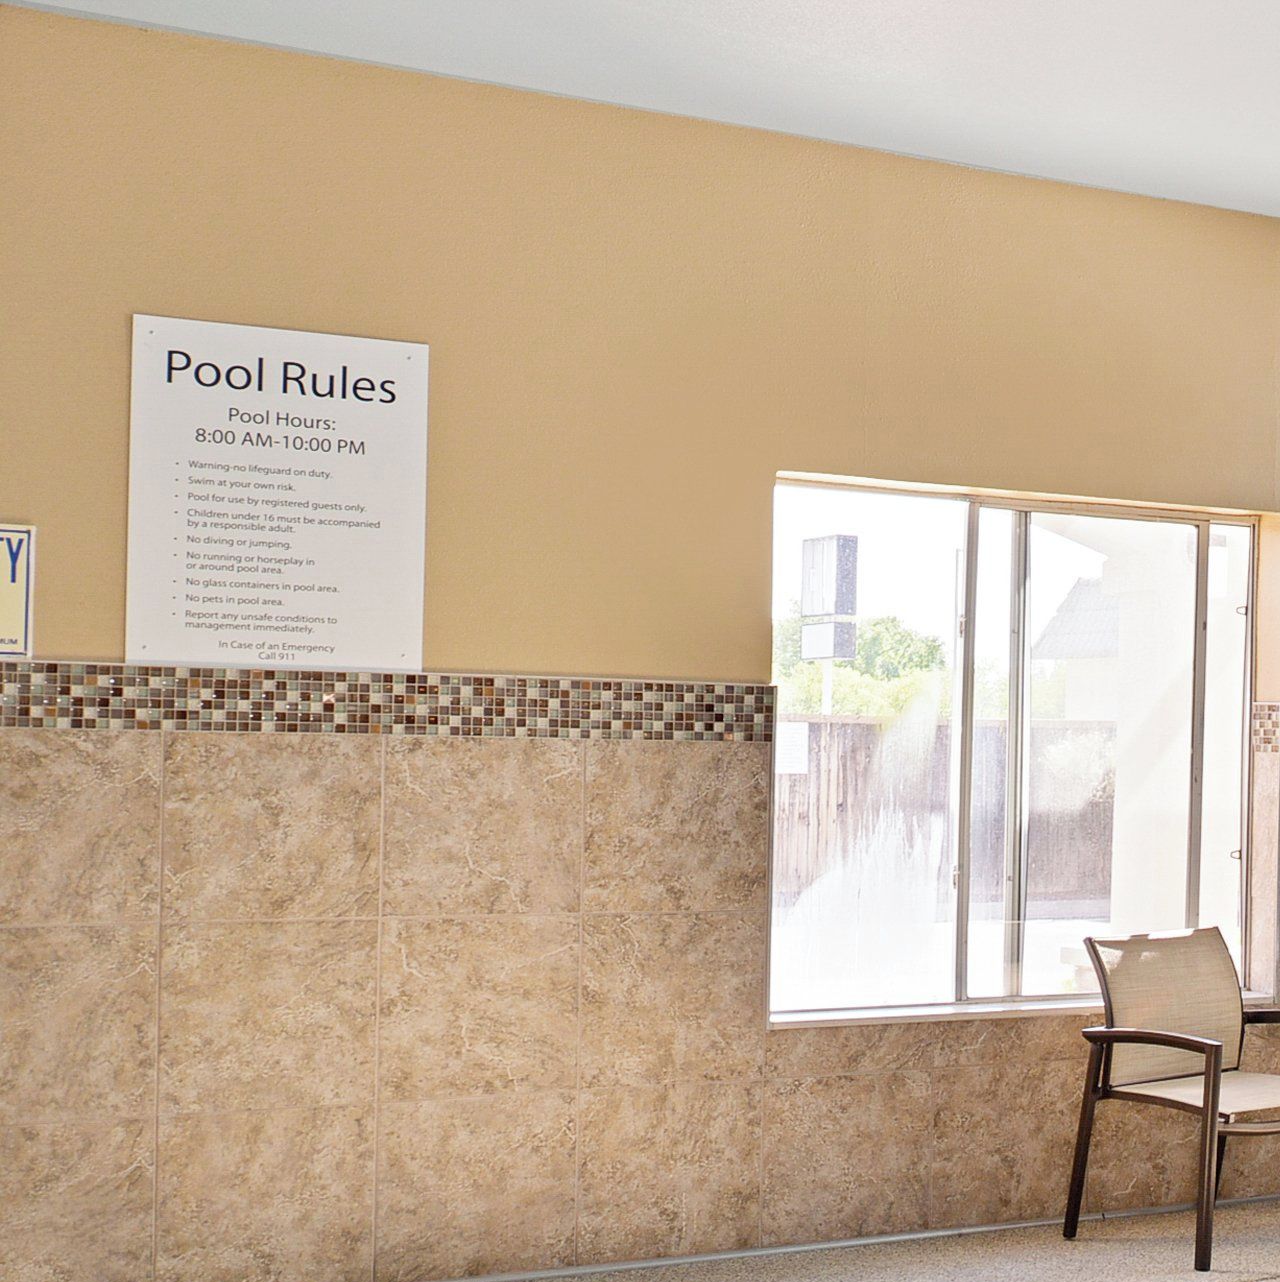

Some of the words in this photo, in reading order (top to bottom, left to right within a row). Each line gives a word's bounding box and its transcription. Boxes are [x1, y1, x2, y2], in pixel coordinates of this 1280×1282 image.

[166, 350, 264, 392] Pool
[282, 361, 396, 403] Rules
[228, 407, 270, 425] Pool
[276, 411, 336, 431] Hours:
[195, 428, 235, 445] 8:00
[241, 431, 332, 452] AM-10:00
[337, 439, 366, 456] PM
[188, 477, 214, 486] Swim
[229, 481, 251, 489] your
[277, 483, 295, 492] risk.
[187, 493, 209, 501] Pool
[211, 494, 225, 503] for
[247, 497, 258, 506] by
[261, 499, 309, 509] registered
[312, 503, 342, 512] guests
[345, 503, 367, 512] only.
[187, 509, 229, 519] Children
[231, 512, 260, 521] under
[264, 514, 274, 522] 16
[277, 515, 300, 524] must
[303, 516, 315, 524] be
[317, 518, 380, 529] accompanied
[187, 519, 199, 528] by
[210, 521, 266, 532] responsible
[268, 524, 295, 533] adult.
[187, 535, 201, 543] No
[203, 536, 234, 547] diving
[249, 540, 292, 550] jumping.
[0, 537, 24, 583] Y
[186, 552, 200, 560] No
[203, 554, 242, 564] running
[257, 555, 304, 567] horseplay
[306, 558, 315, 566] in
[199, 564, 234, 572] around
[237, 565, 259, 575] pool
[186, 578, 200, 586] No
[202, 579, 226, 589] glass
[229, 581, 279, 590] containers
[294, 583, 315, 593] pool
[185, 594, 199, 602] No
[202, 595, 223, 604] pets
[237, 597, 259, 606] pool
[185, 610, 218, 620] Report
[221, 613, 238, 622] any
[241, 613, 273, 622] unsafe
[275, 615, 325, 624] conditions
[185, 622, 250, 631] management
[253, 623, 315, 634] immediately.
[231, 641, 253, 649] Case
[256, 642, 265, 650] of
[282, 643, 335, 654] Emergency
[258, 652, 276, 660] Call
[279, 652, 295, 661] 911
